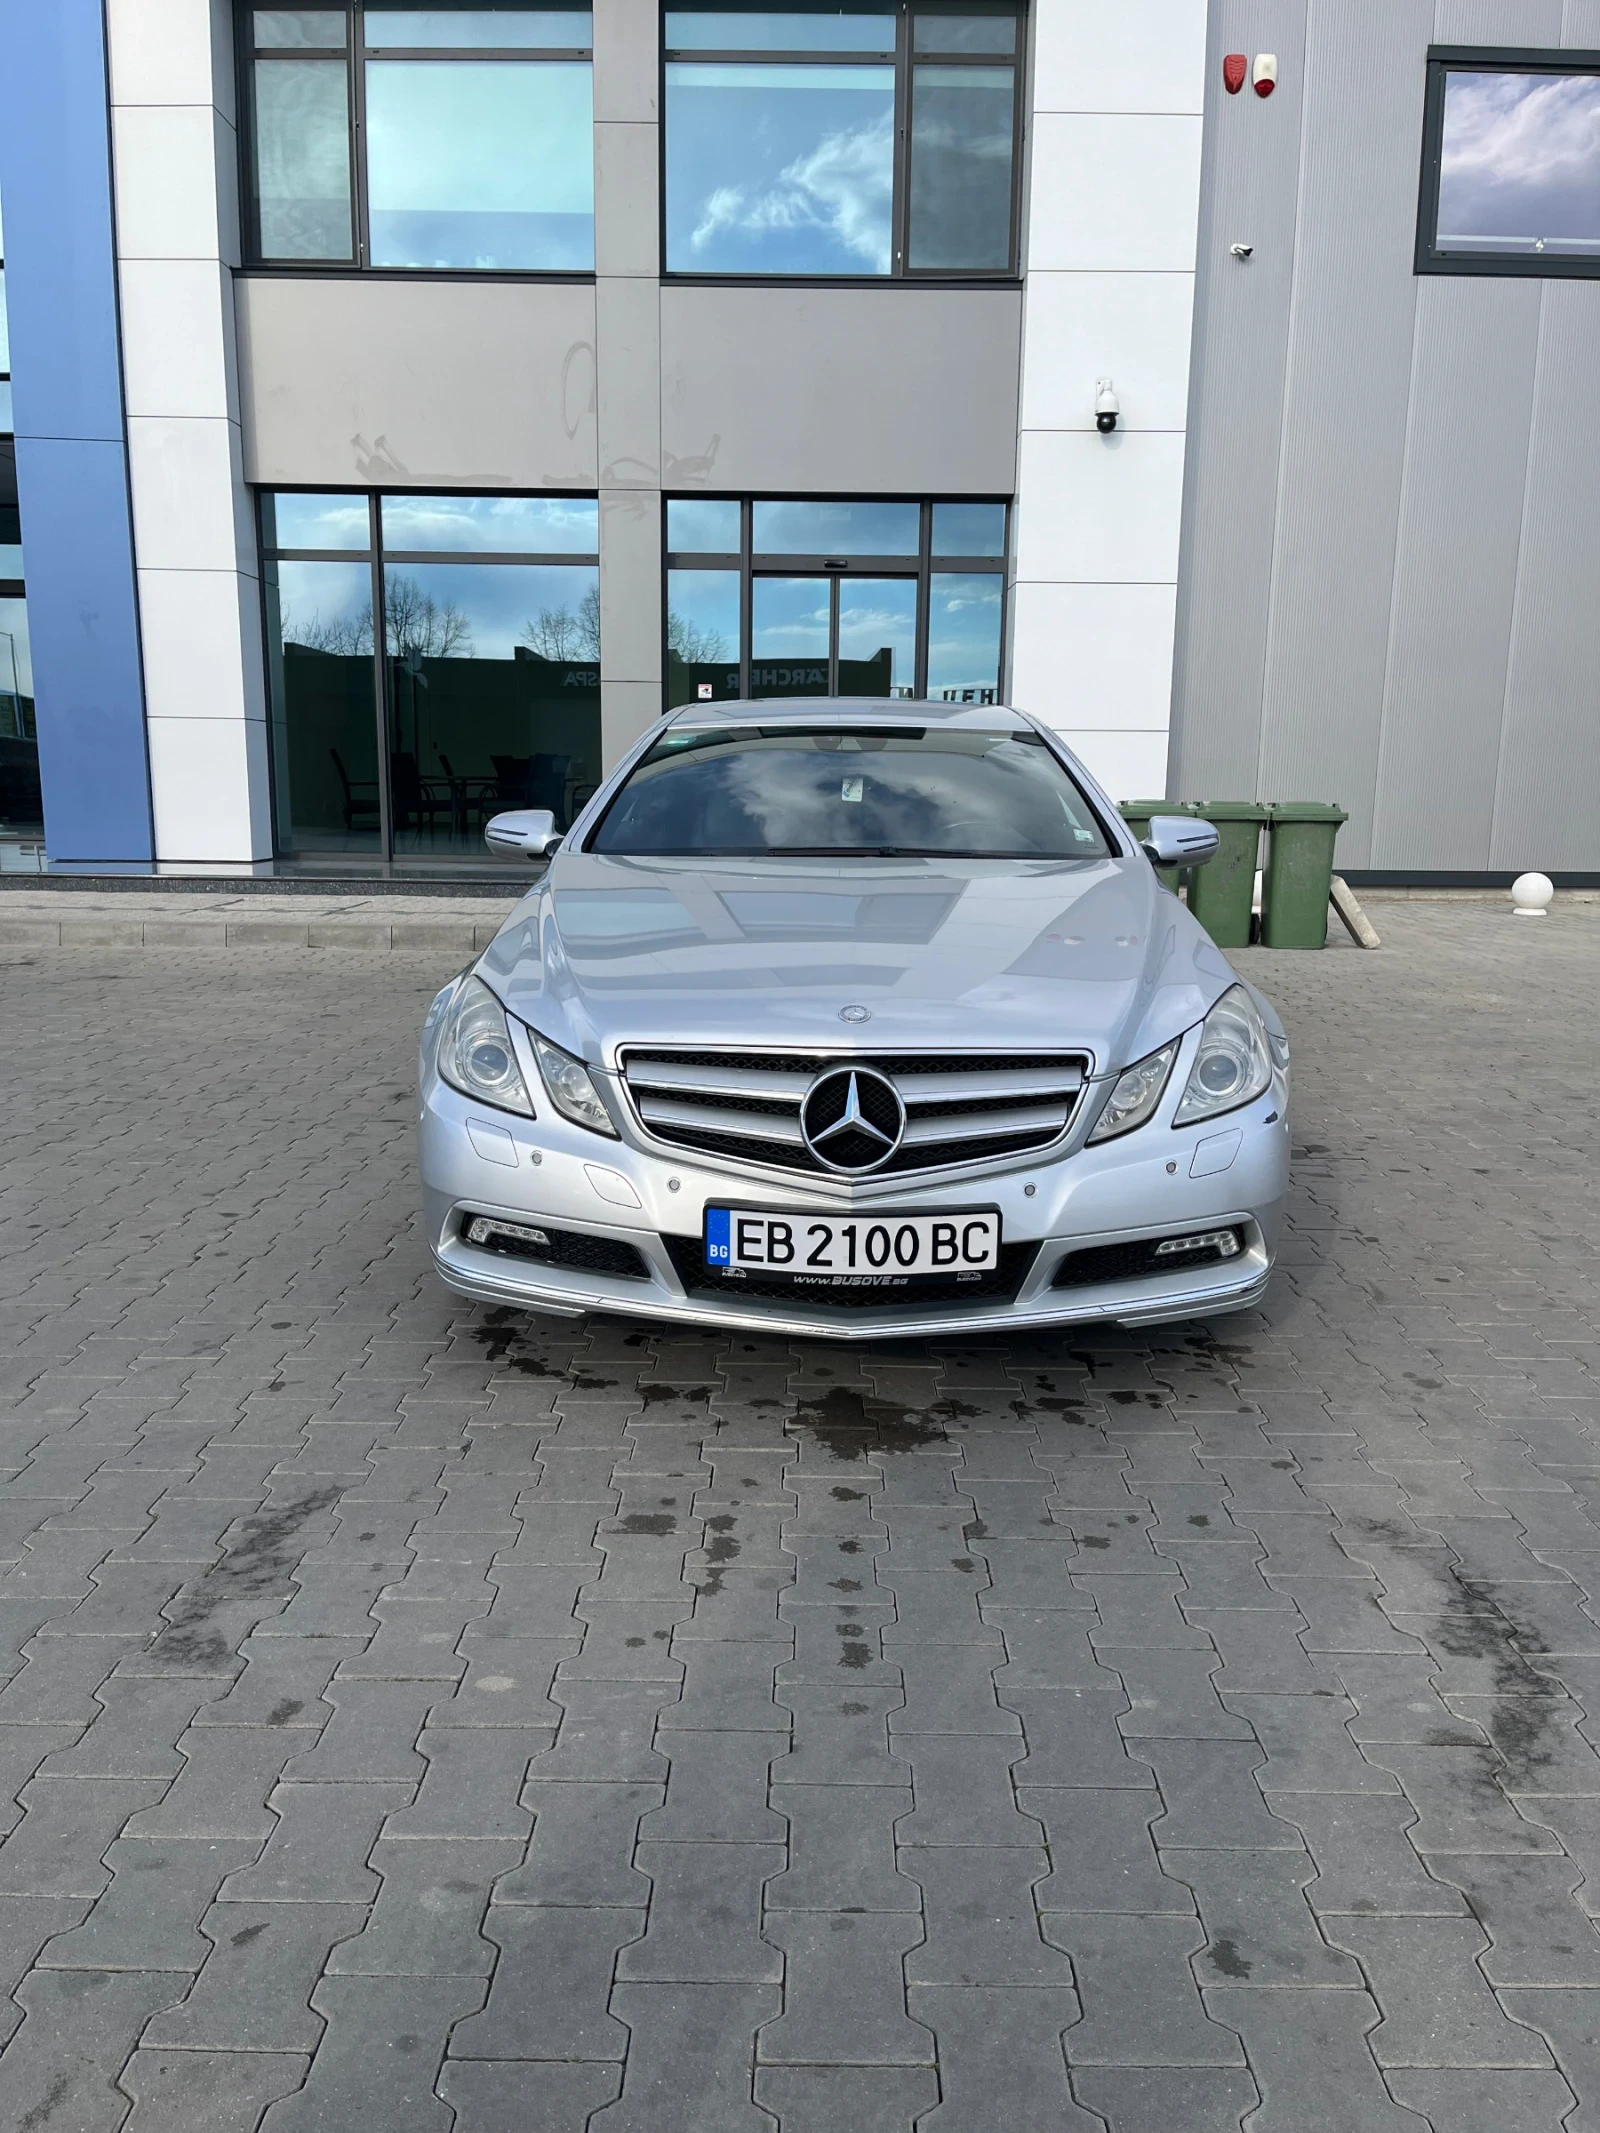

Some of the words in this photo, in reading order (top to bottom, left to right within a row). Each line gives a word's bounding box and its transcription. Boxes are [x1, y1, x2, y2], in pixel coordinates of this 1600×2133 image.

[709, 1244, 728, 1258] BG
[736, 1218, 795, 1265] EB
[806, 1223, 920, 1267] 2100
[931, 1221, 990, 1265] BC
